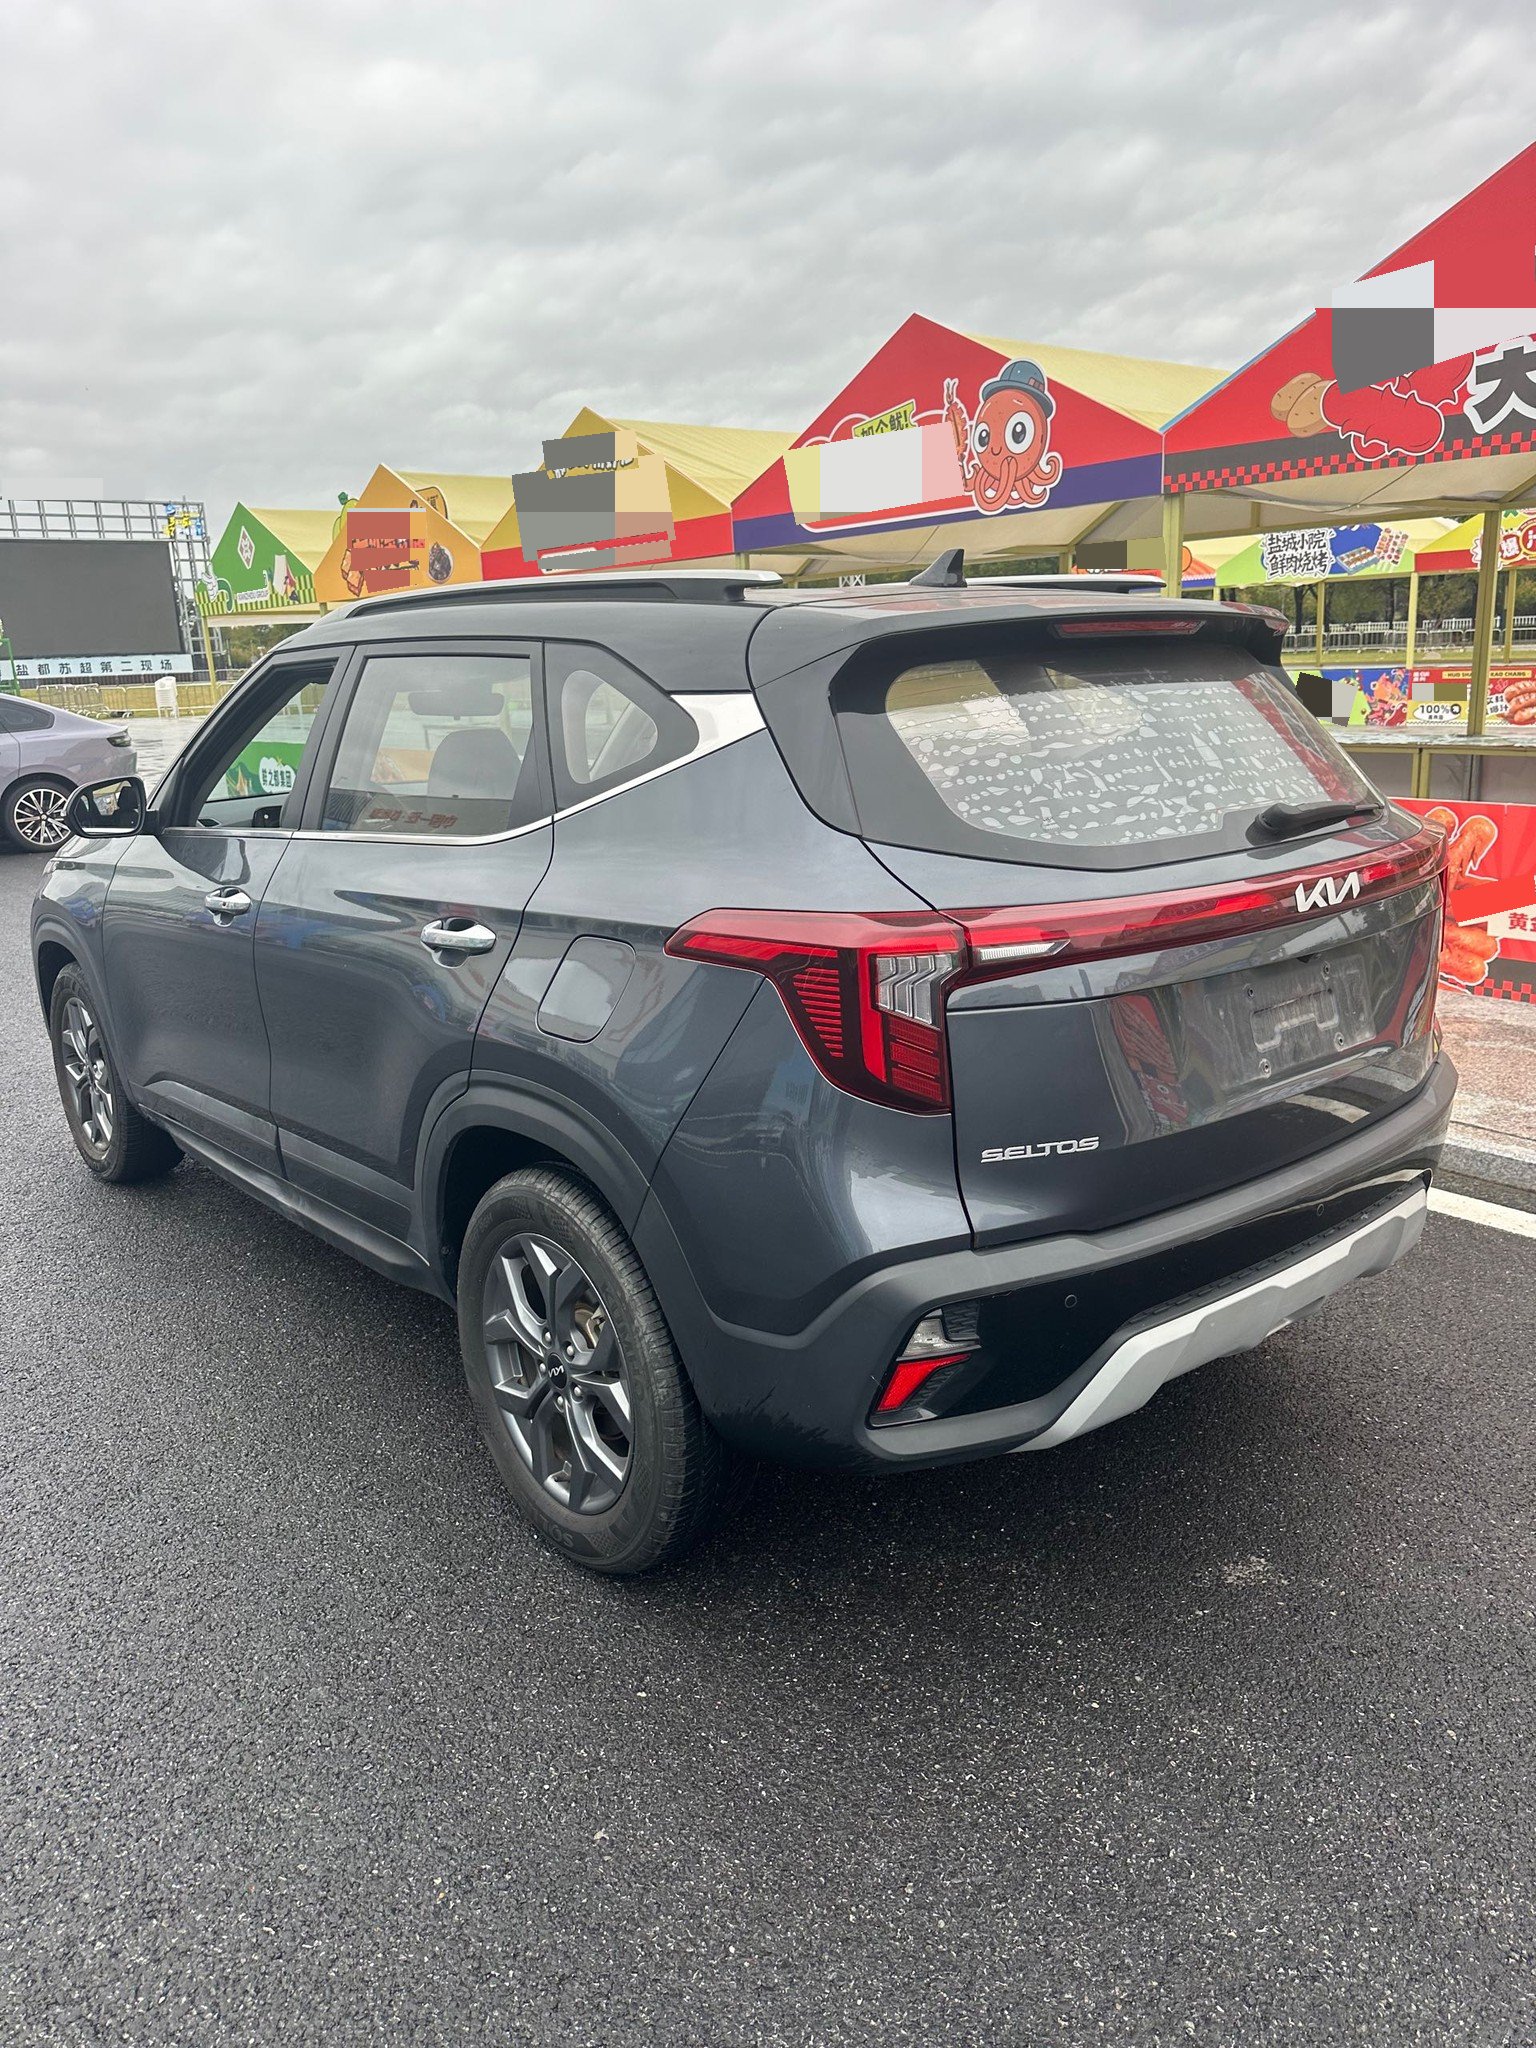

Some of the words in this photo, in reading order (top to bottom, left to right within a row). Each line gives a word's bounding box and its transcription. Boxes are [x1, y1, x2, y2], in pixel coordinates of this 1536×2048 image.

[1267, 529, 1327, 556] 盐城小院
[1269, 549, 1329, 576] 鲜肉烧烤
[15, 659, 173, 676] 盐都苏超第二现场
[1420, 704, 1450, 714] 100%
[1295, 871, 1360, 913] KIA
[980, 1136, 1100, 1163] SELTOS
